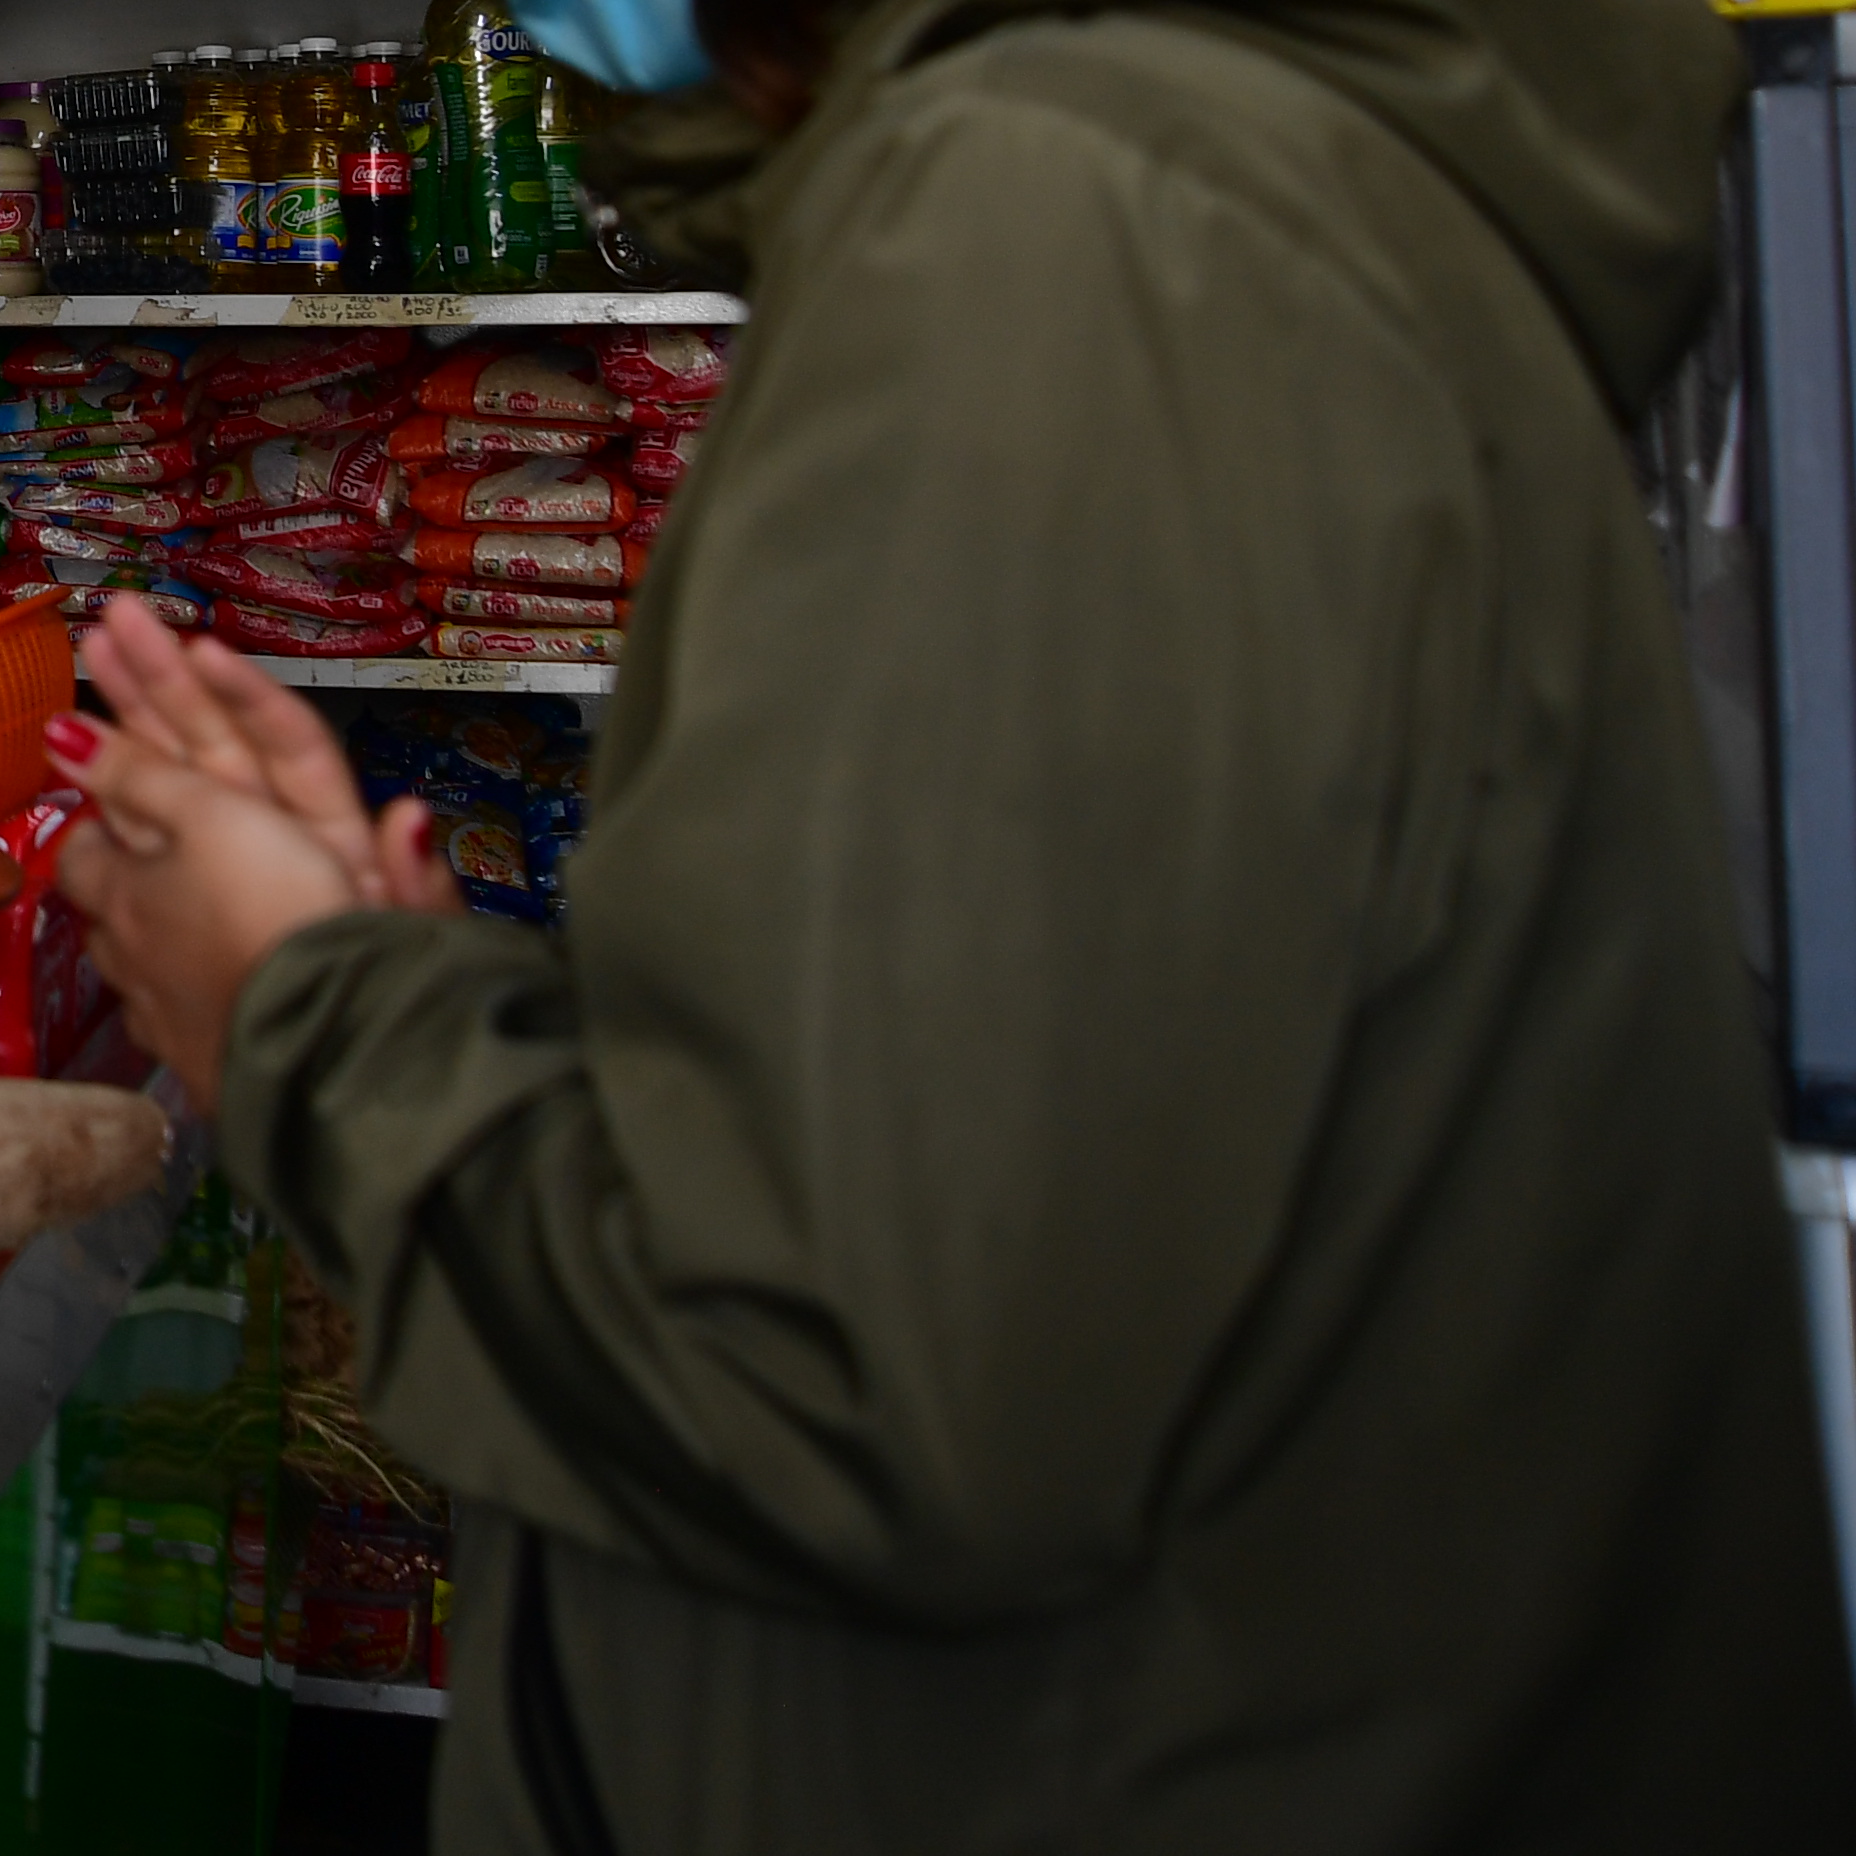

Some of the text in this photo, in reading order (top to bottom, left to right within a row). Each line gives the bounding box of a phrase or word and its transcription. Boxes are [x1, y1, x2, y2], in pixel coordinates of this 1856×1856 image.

[351, 164, 404, 184] Coca-Cola
[54, 430, 89, 449] DIANA
[59, 464, 96, 481] DIANA
[77, 495, 114, 512] DIANA
